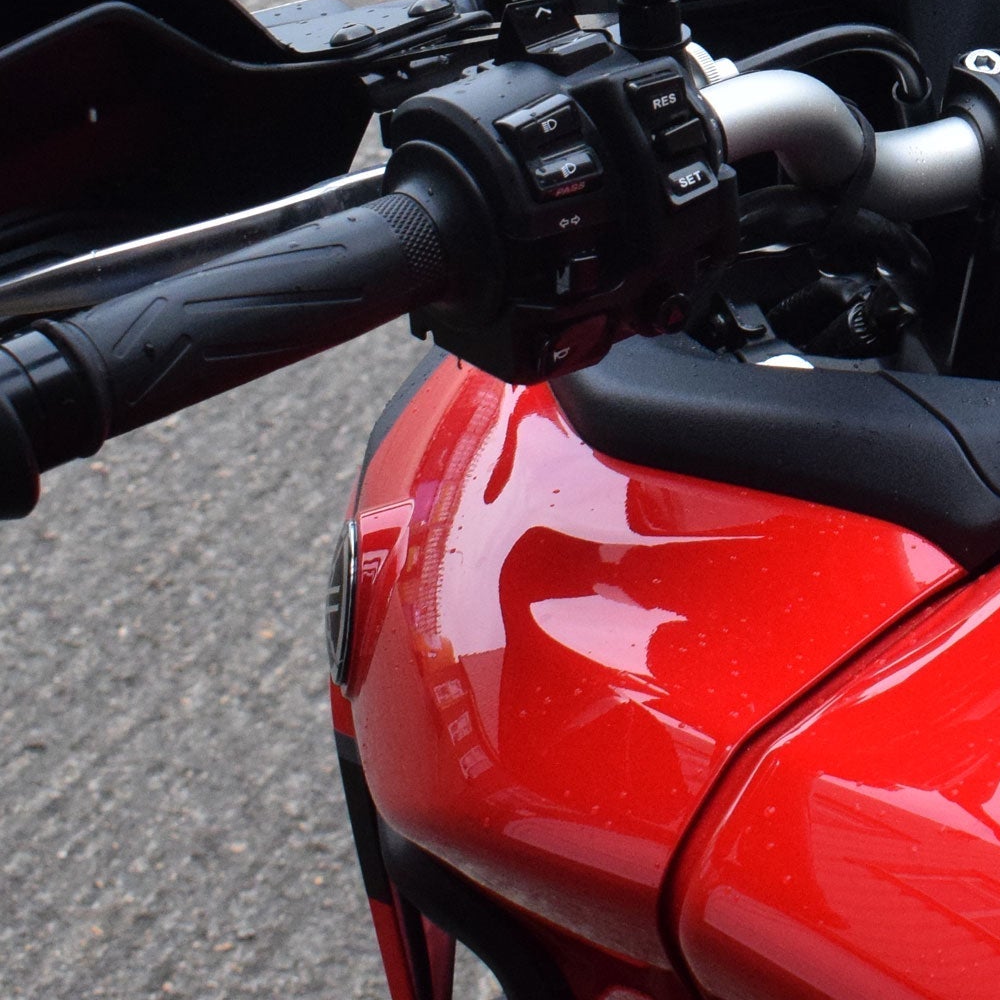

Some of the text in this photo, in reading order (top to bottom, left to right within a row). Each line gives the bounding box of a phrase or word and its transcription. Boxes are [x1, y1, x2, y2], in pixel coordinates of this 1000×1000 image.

[652, 92, 678, 111] RES
[678, 169, 703, 189] SET
[554, 180, 586, 198] PASS
